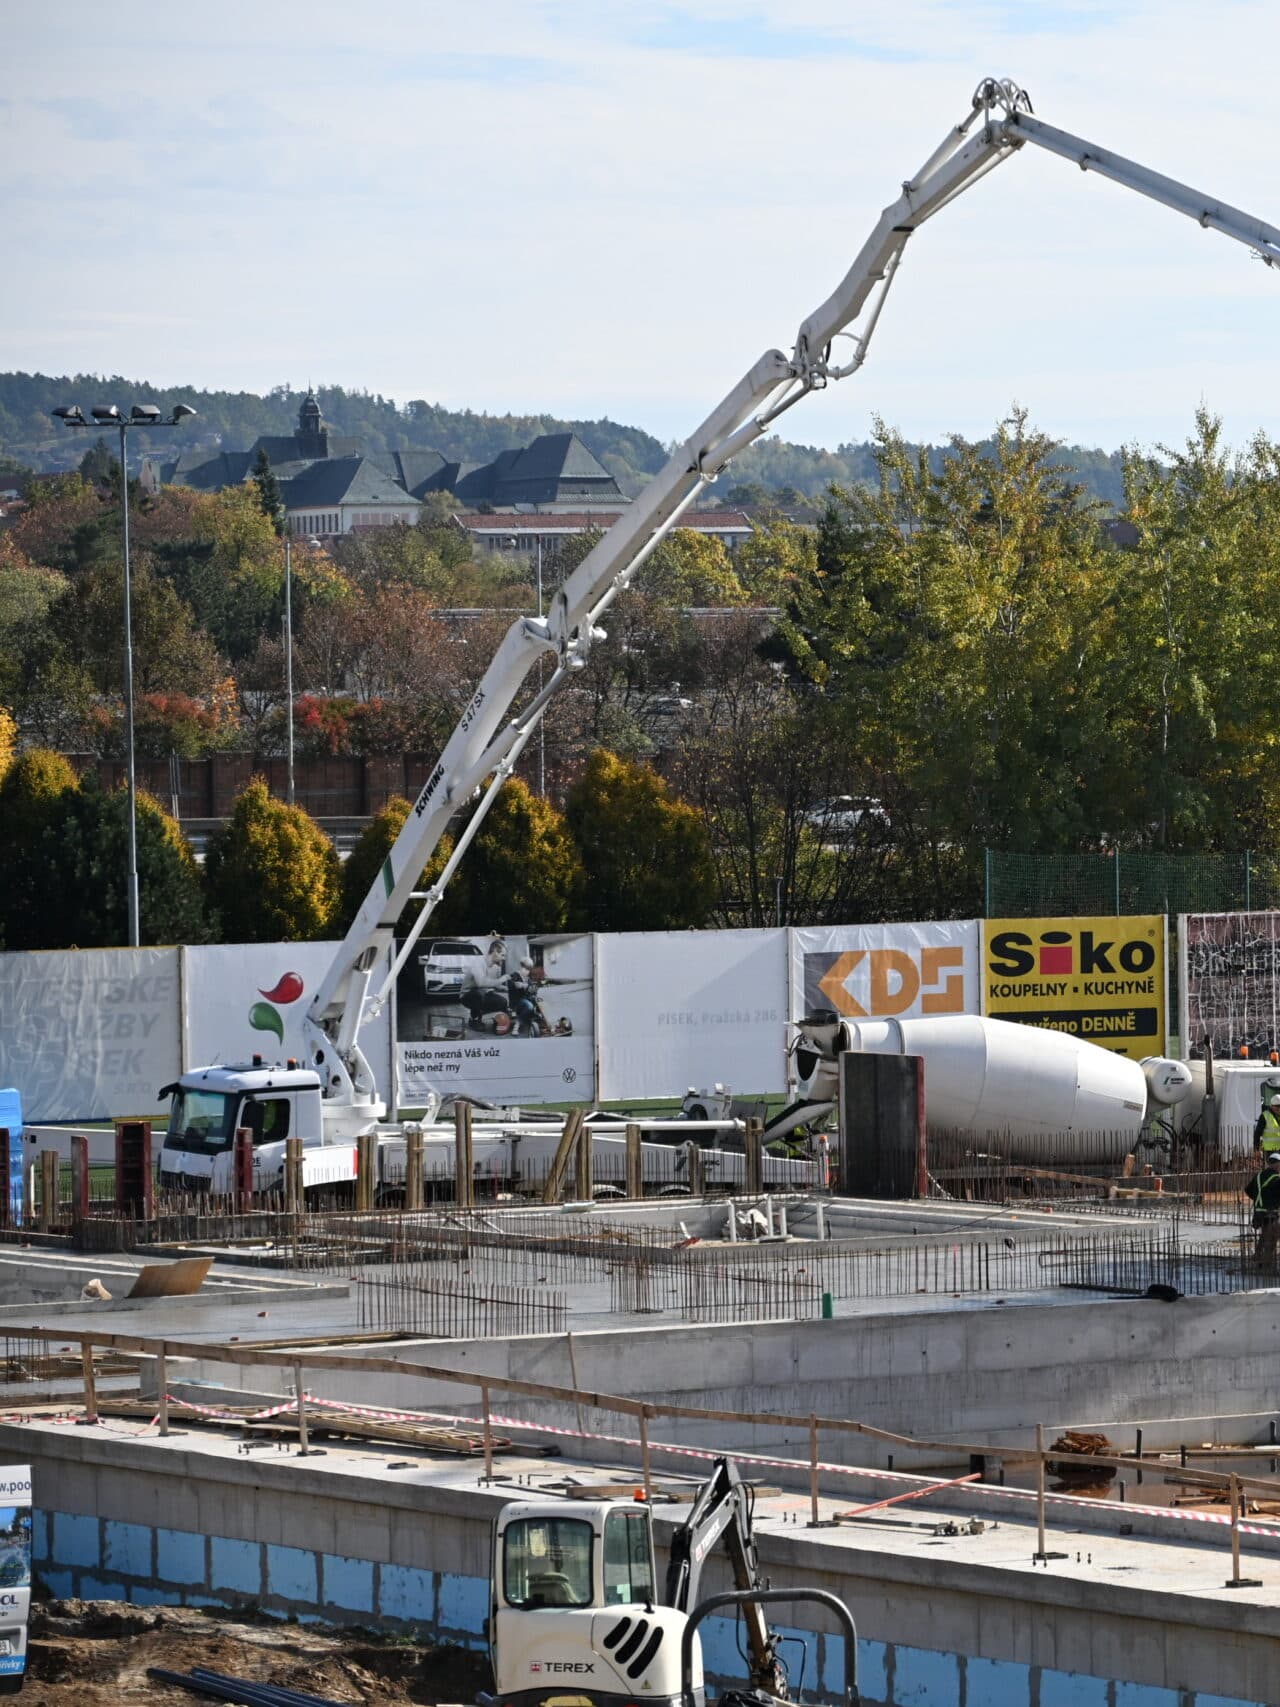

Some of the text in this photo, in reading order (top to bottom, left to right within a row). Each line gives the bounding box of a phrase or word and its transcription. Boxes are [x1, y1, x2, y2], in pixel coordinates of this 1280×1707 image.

[415, 763, 445, 818] SCHWING
[989, 976, 1155, 998] KOUPELNY KUCHYNĚ
[1081, 1011, 1136, 1032] DENNĚ
[404, 1047, 500, 1061] Nikdo nezná Váš vůz
[404, 1062, 461, 1074] lépe než my
[544, 1662, 595, 1674] TEREX
